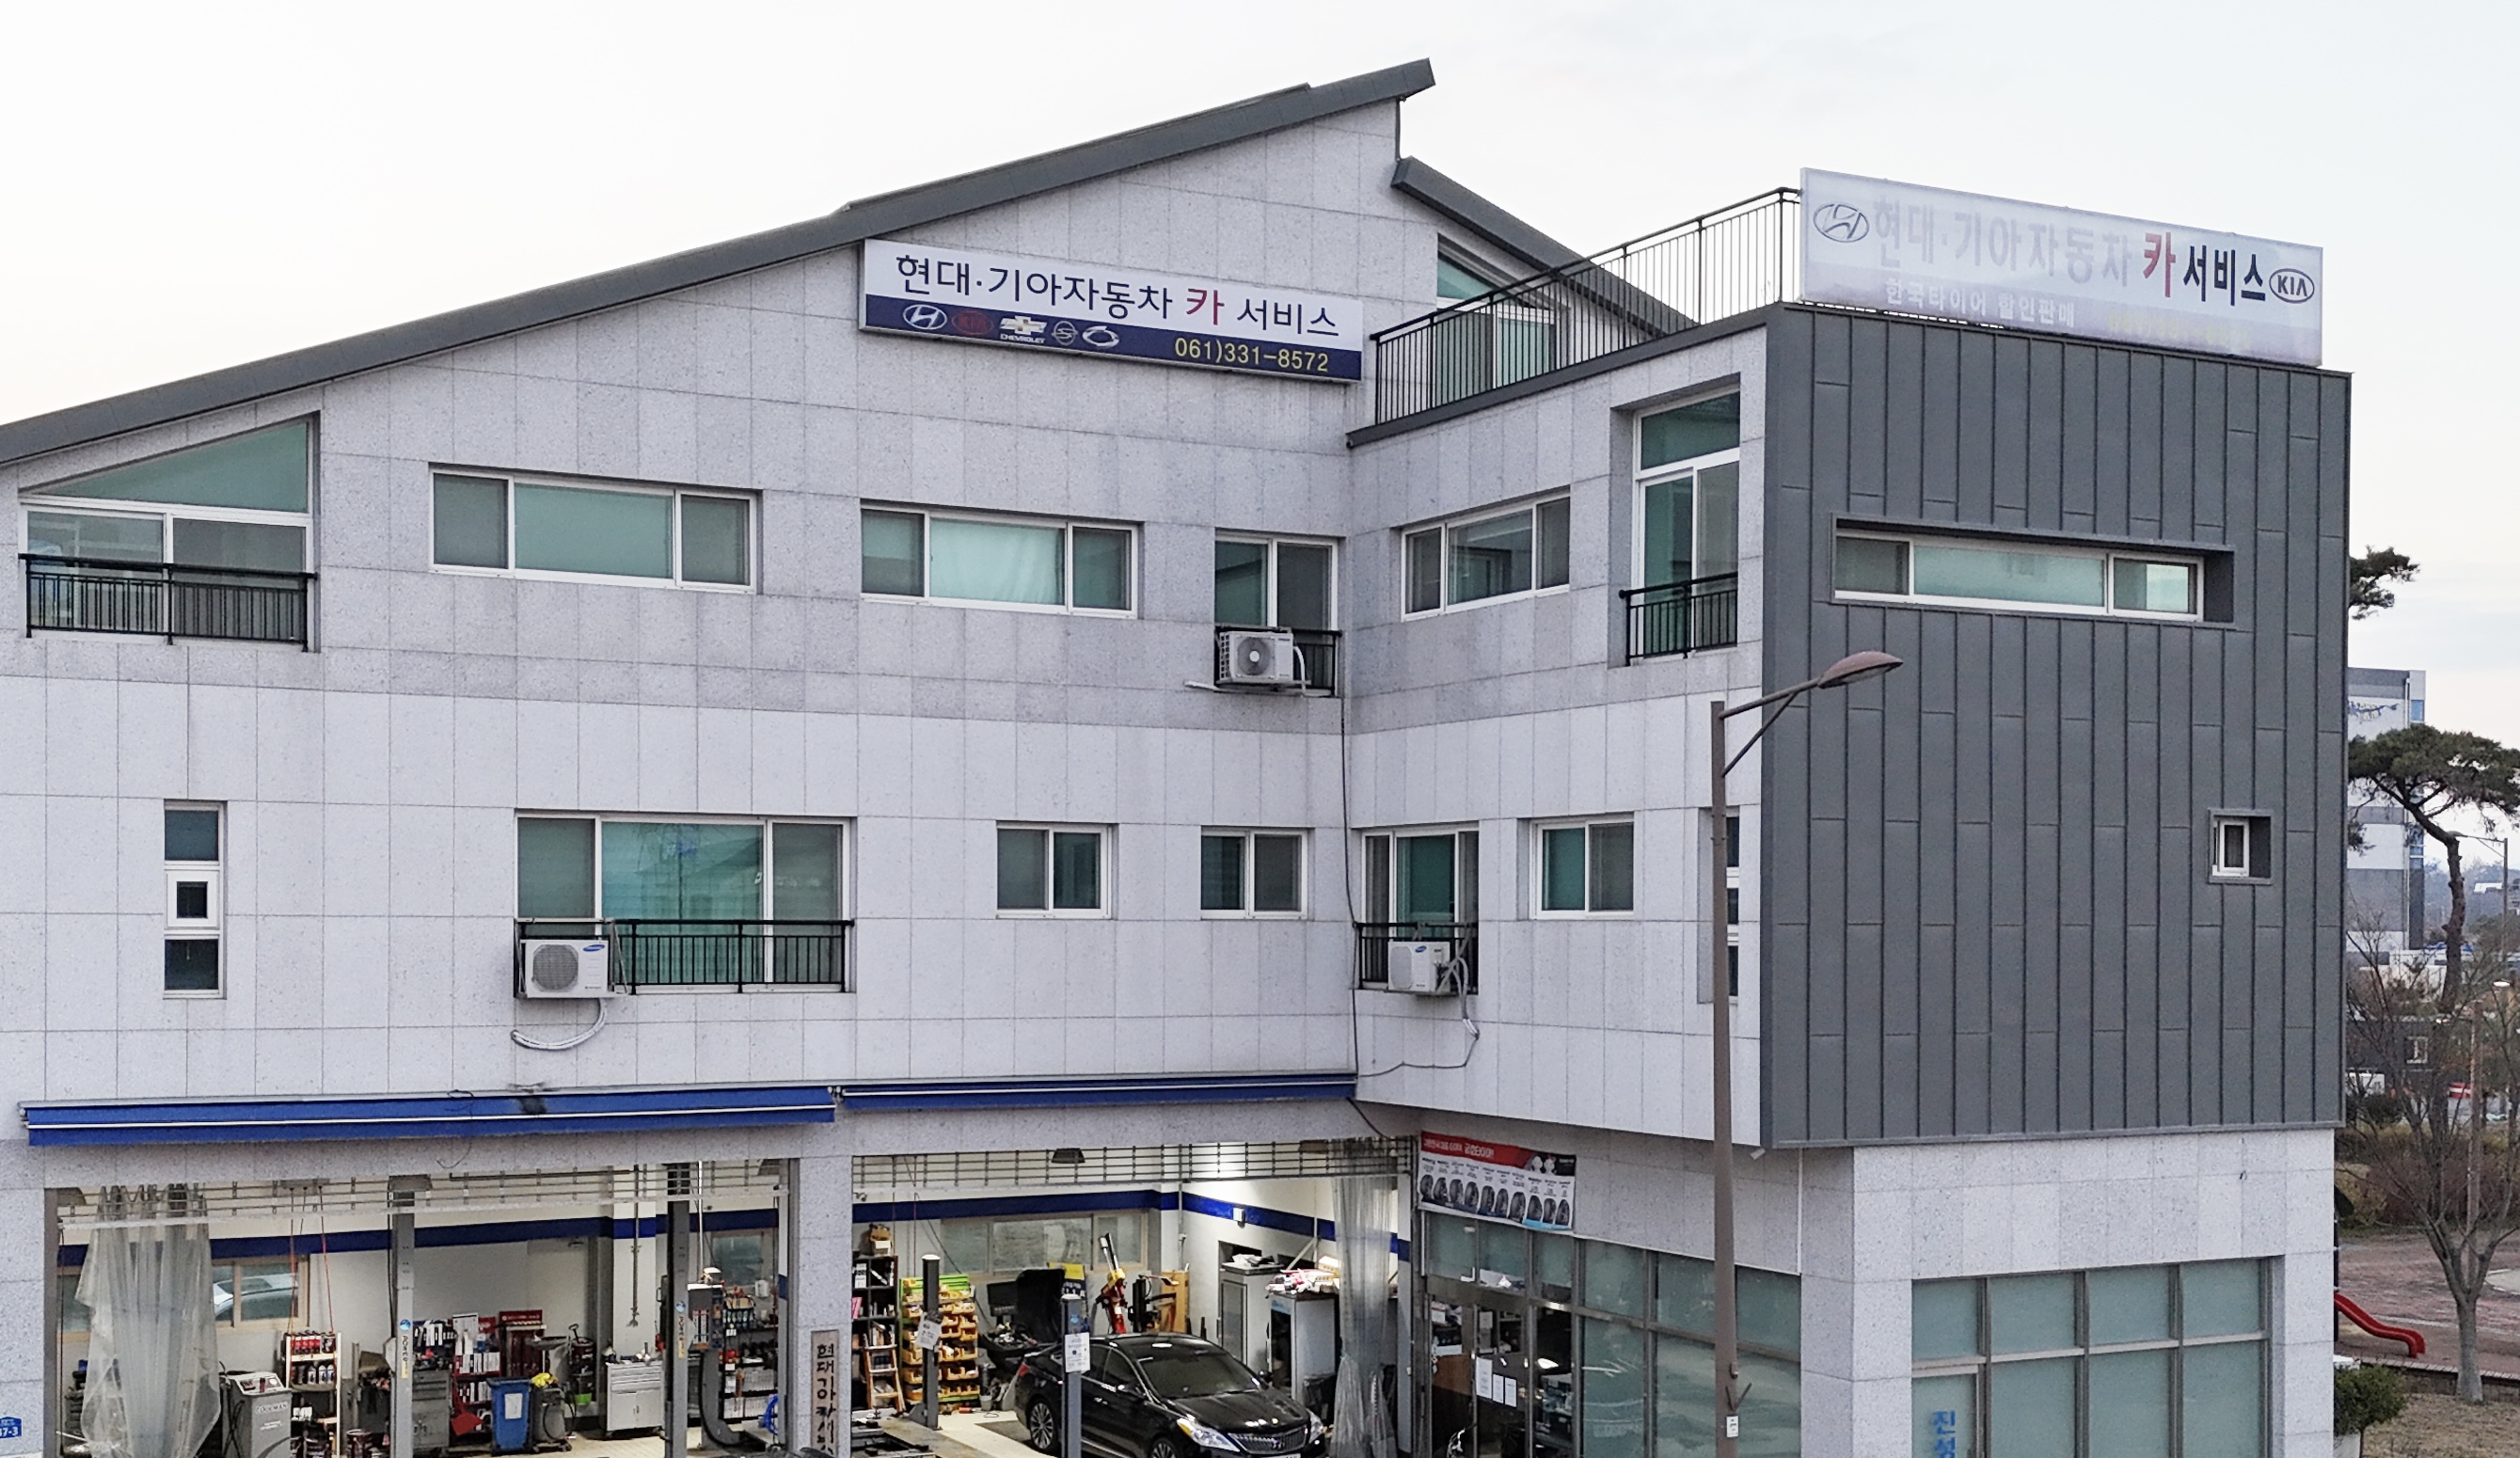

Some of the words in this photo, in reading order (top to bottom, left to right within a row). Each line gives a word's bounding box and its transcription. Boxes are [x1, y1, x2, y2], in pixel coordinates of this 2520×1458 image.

[2143, 231, 2177, 298] 카
[2182, 245, 2266, 306] 서비스
[2276, 274, 2308, 297] KIA
[895, 254, 1173, 320] 현대·기아자동차
[1185, 287, 1226, 325] 카
[1237, 298, 1339, 337] 서비스
[1885, 277, 1987, 317] 한국타이어
[1997, 292, 2075, 327] 할인판매
[1000, 333, 1046, 344] CHEVROLET
[1174, 337, 1329, 372] 061)331-8572
